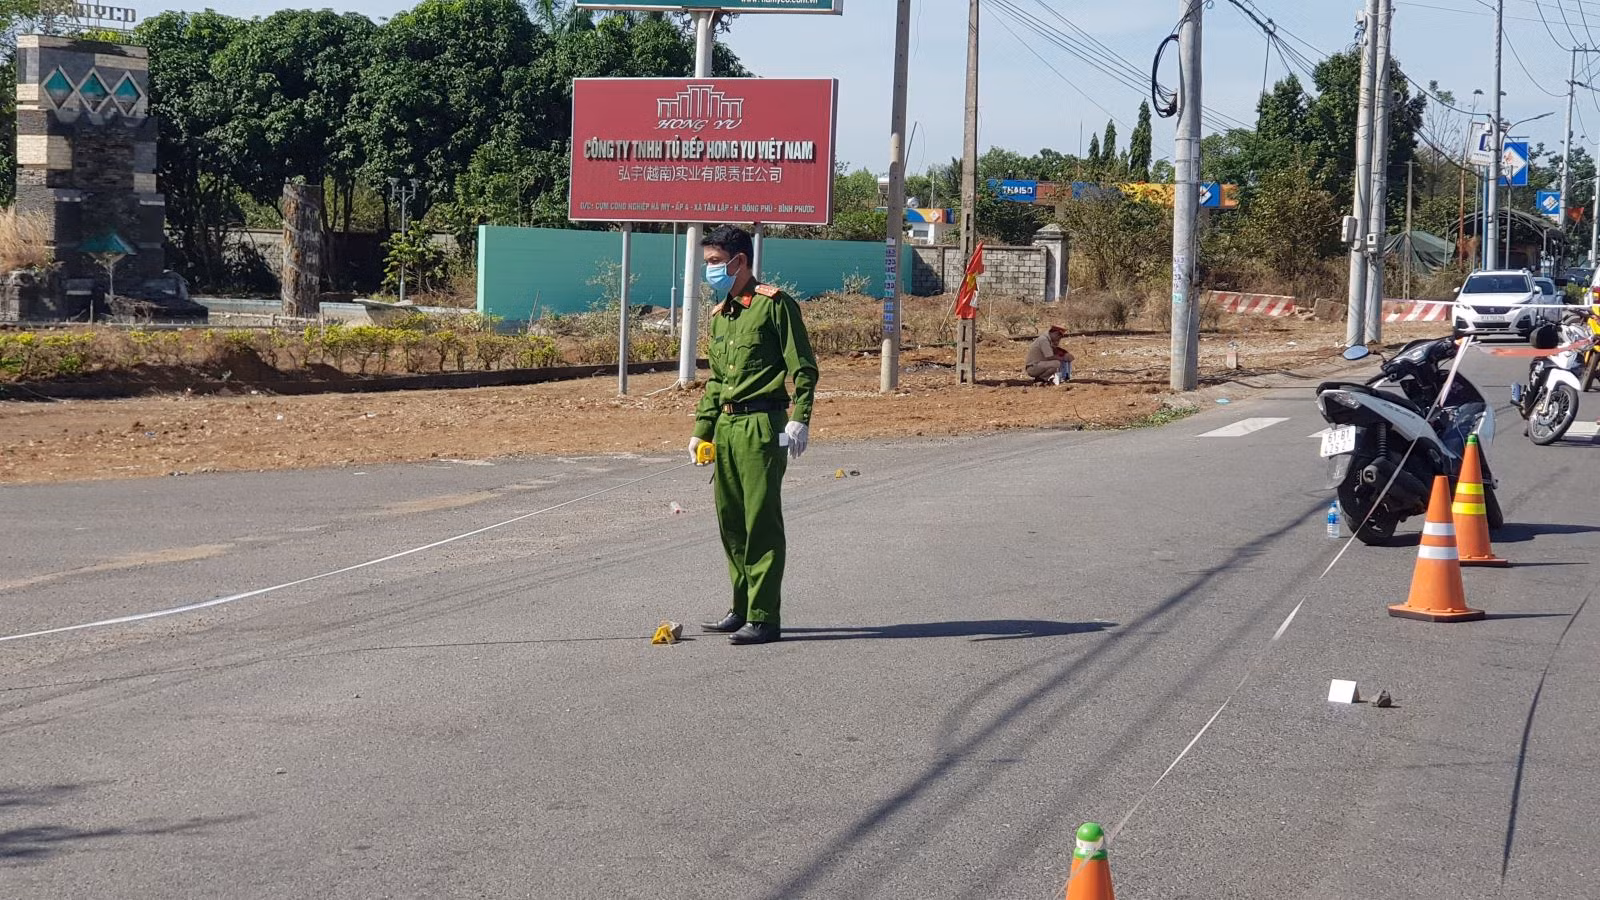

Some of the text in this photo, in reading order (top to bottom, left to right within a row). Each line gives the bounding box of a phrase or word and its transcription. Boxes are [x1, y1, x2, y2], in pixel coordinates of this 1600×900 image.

[655, 118, 742, 133] HONG YU
[583, 134, 814, 163] CÔNG TY TNHH TỦ BẾP HONG YU VIỆT NAM
[618, 165, 783, 184] 弘宇(越南)实业有限责任公司
[703, 202, 717, 212] TÂN
[778, 203, 794, 213] BÌNH
